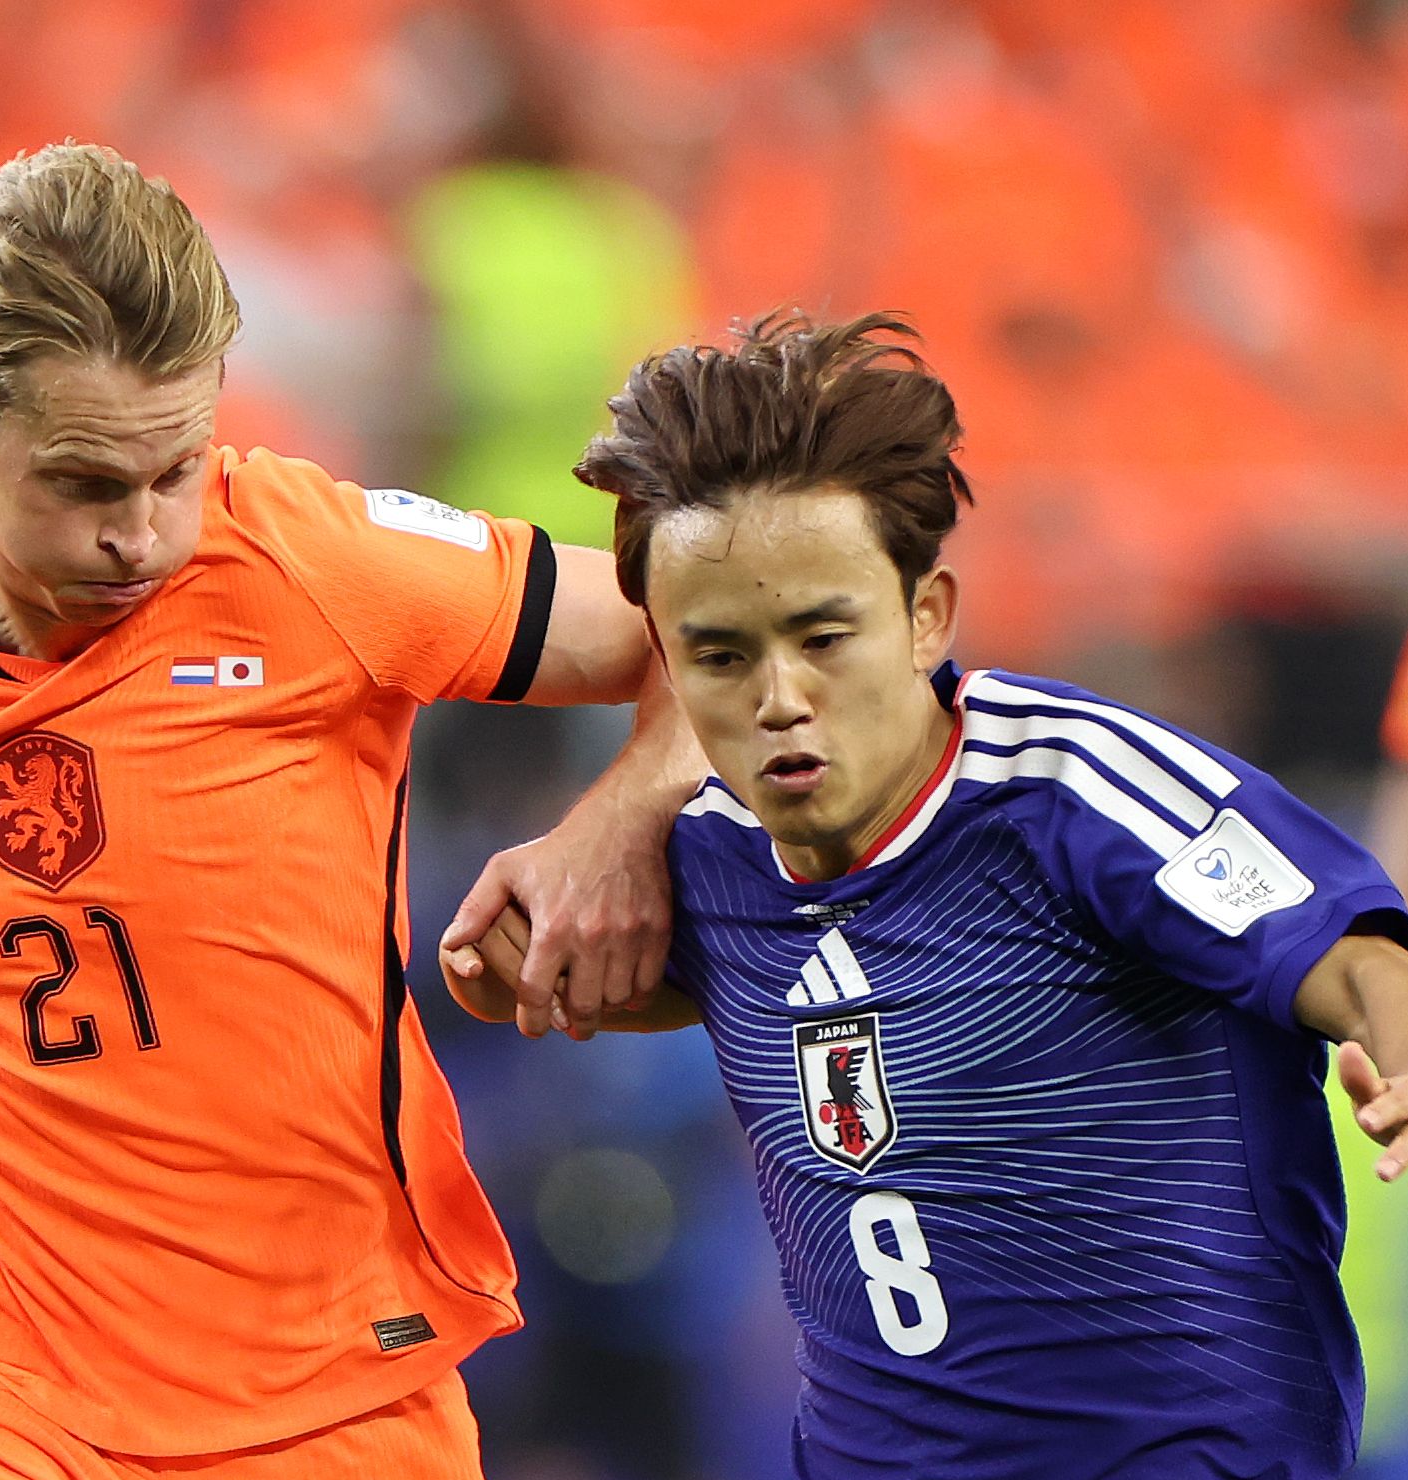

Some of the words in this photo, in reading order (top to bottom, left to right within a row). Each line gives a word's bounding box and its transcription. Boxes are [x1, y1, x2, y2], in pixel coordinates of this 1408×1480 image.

[1239, 864, 1260, 885] For
[1229, 878, 1276, 908] PEACE
[815, 1022, 859, 1041] JAPAN
[833, 1119, 875, 1148] JFA
[848, 1190, 949, 1357] 8
